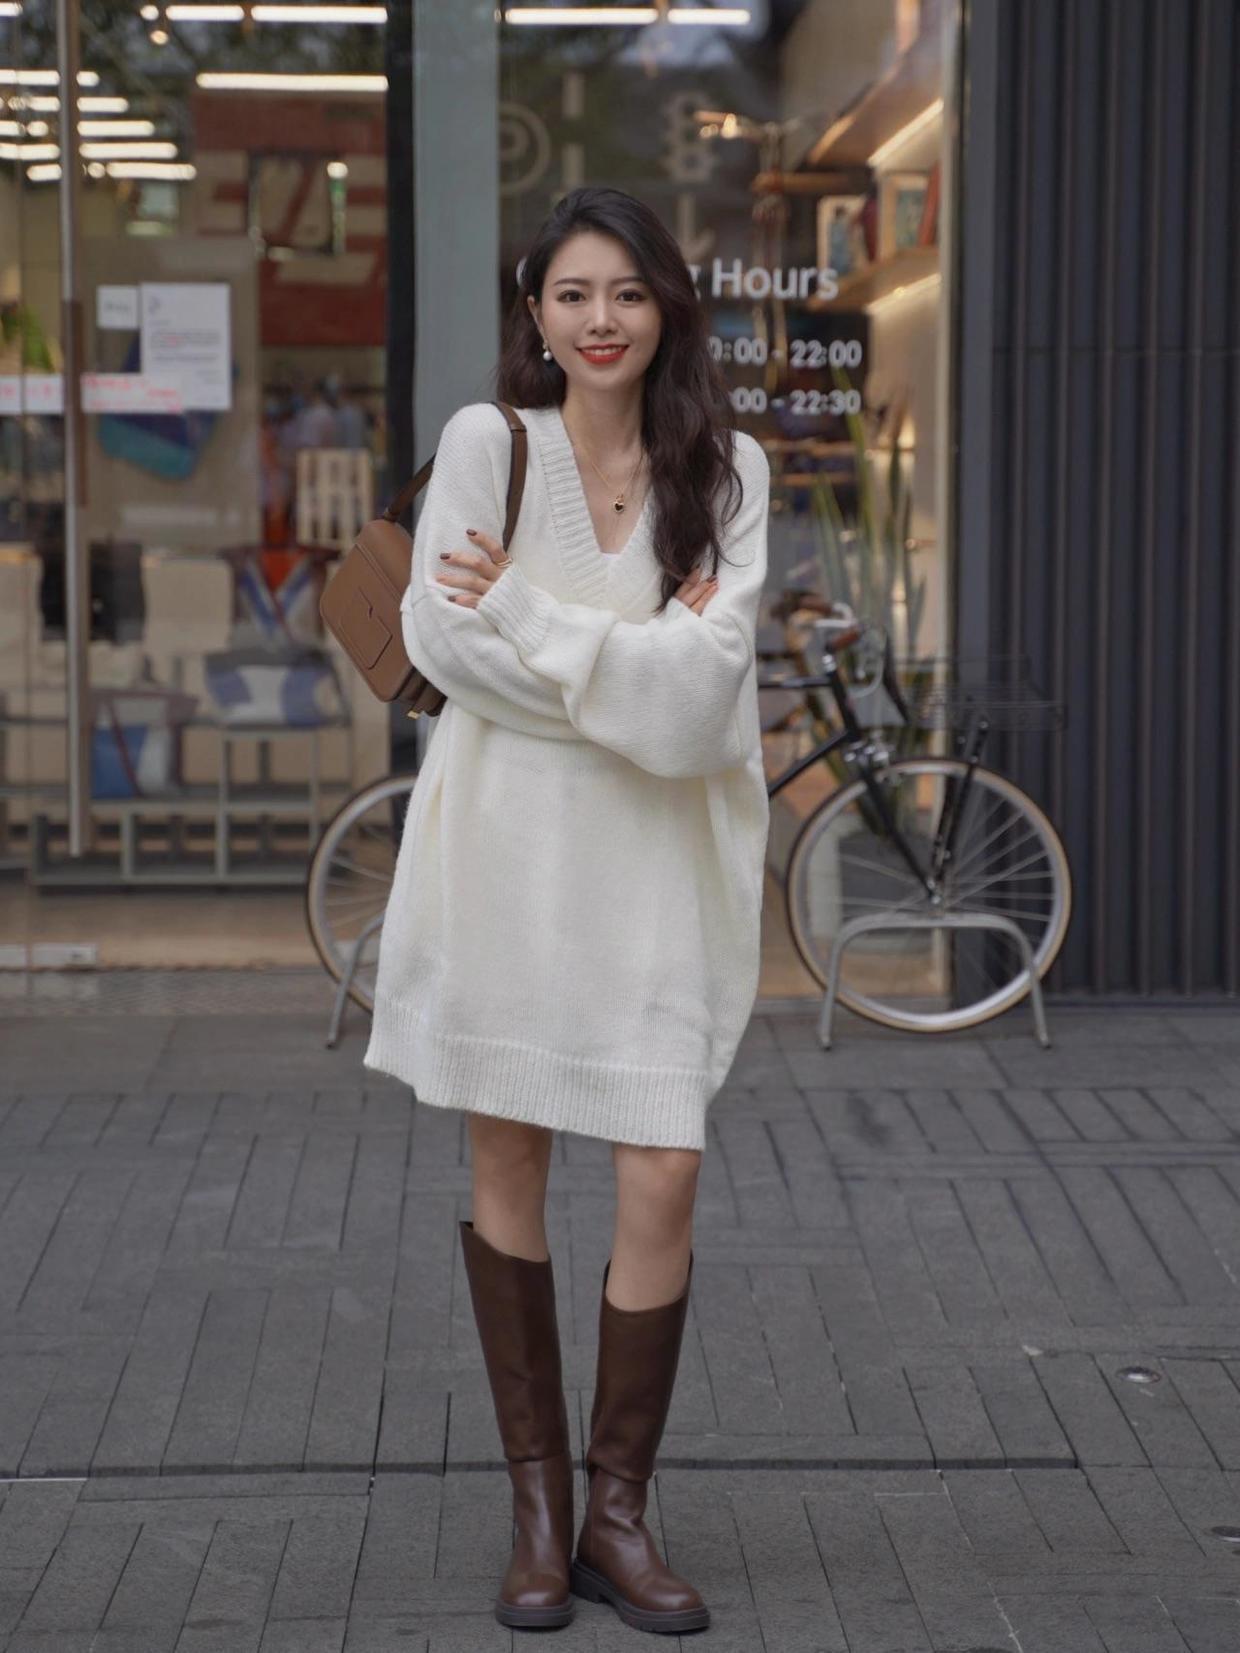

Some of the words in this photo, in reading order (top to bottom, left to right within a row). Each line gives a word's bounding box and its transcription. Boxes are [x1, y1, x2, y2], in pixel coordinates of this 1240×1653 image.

[711, 257, 839, 299] Hours
[708, 336, 768, 366] 0:00
[790, 339, 863, 368] 22:00
[731, 387, 768, 414] 00
[789, 389, 862, 415] 22:30
